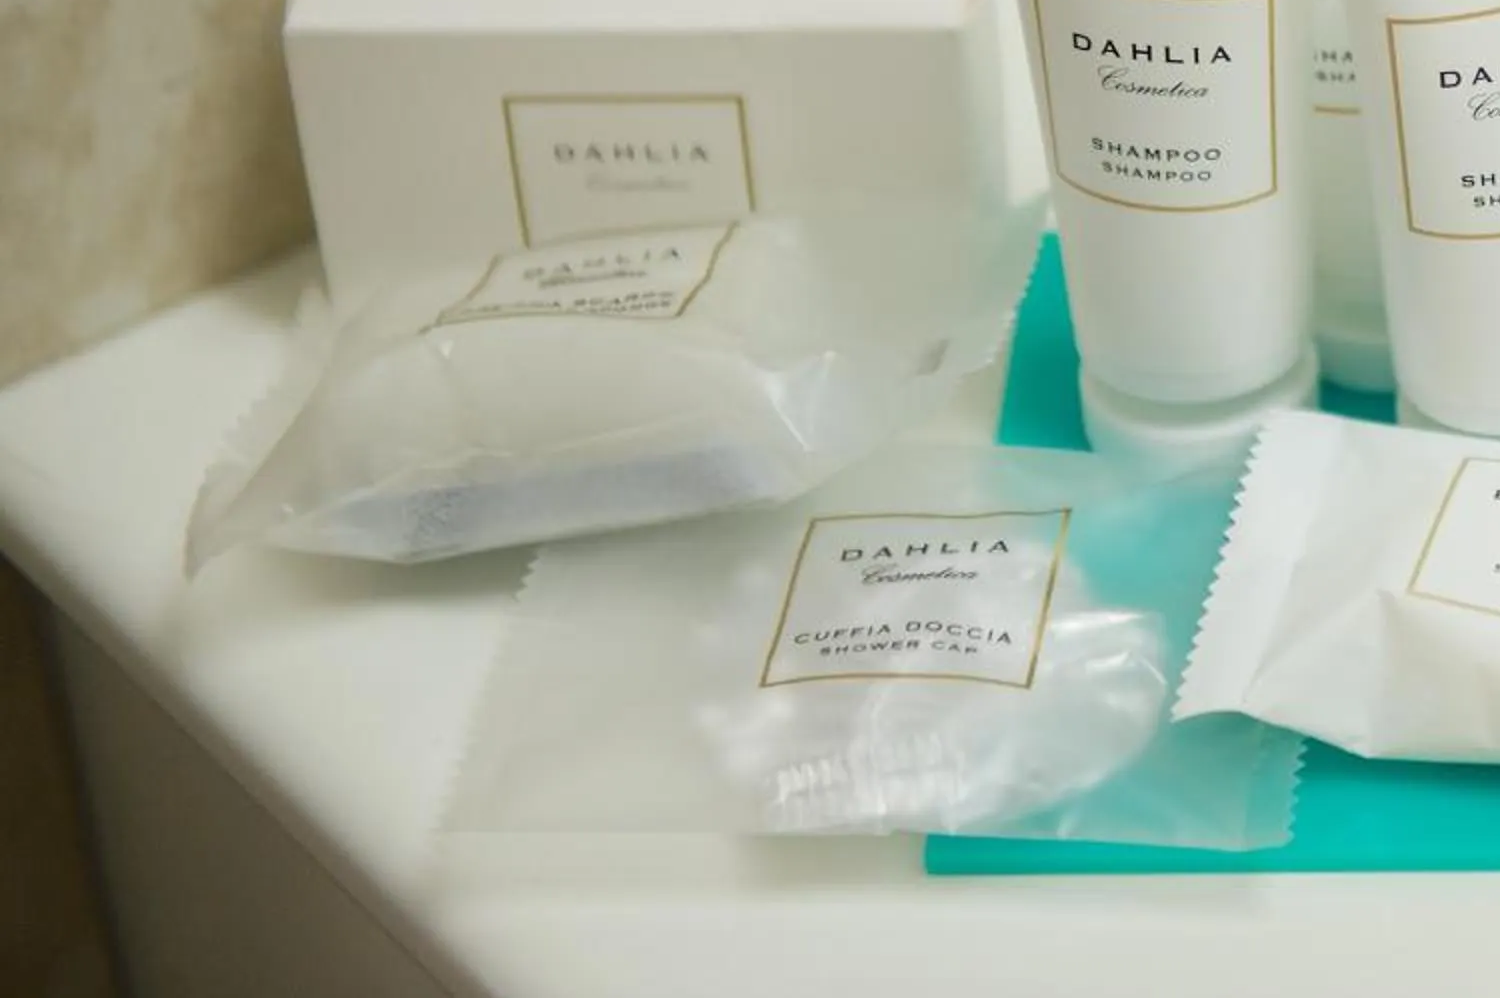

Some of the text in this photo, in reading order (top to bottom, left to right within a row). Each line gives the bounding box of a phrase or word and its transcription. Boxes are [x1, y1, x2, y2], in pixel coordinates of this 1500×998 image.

[1071, 32, 1232, 64] DAHLIA
[1097, 65, 1209, 98] Cosmetica
[553, 143, 709, 163] DAHLIA
[1091, 137, 1222, 163] SHAMPOO
[1102, 161, 1212, 182] SHAMPOO
[840, 539, 1010, 563] DAHLIA
[861, 562, 978, 586] Cosmetica
[793, 620, 1012, 646] CUFFIA DOCCIA
[818, 639, 980, 657] SHOWER CAP
